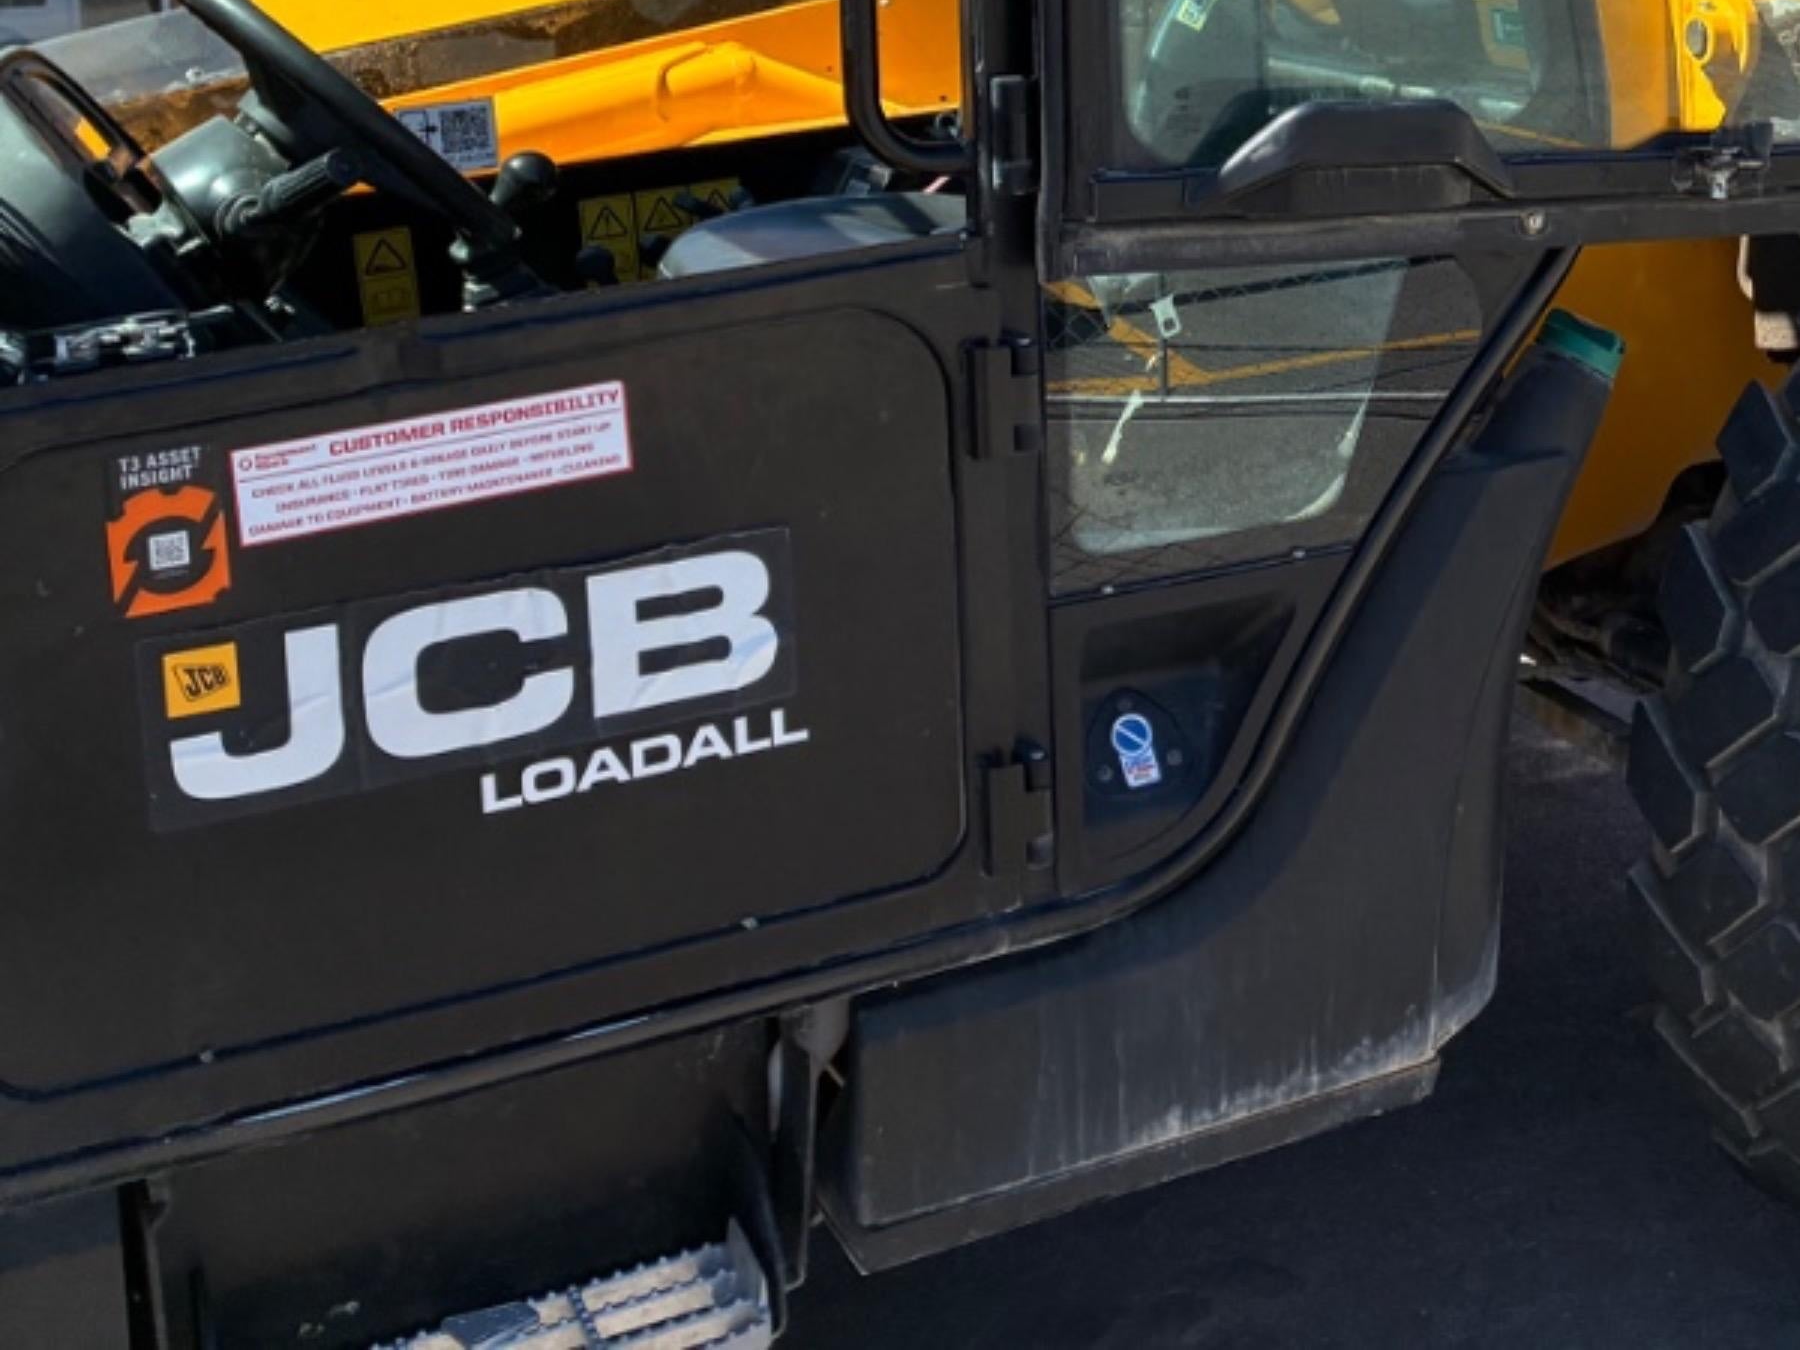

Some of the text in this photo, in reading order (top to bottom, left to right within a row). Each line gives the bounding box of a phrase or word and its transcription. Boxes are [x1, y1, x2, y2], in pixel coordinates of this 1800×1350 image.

[328, 387, 619, 456] CUSTOMER RESPONSIBILITY
[118, 447, 201, 473] T3 ASSET
[119, 464, 193, 490] INSIGHT
[171, 549, 779, 799] JCB
[182, 664, 227, 697] JCB
[481, 709, 809, 814] LOADALL
